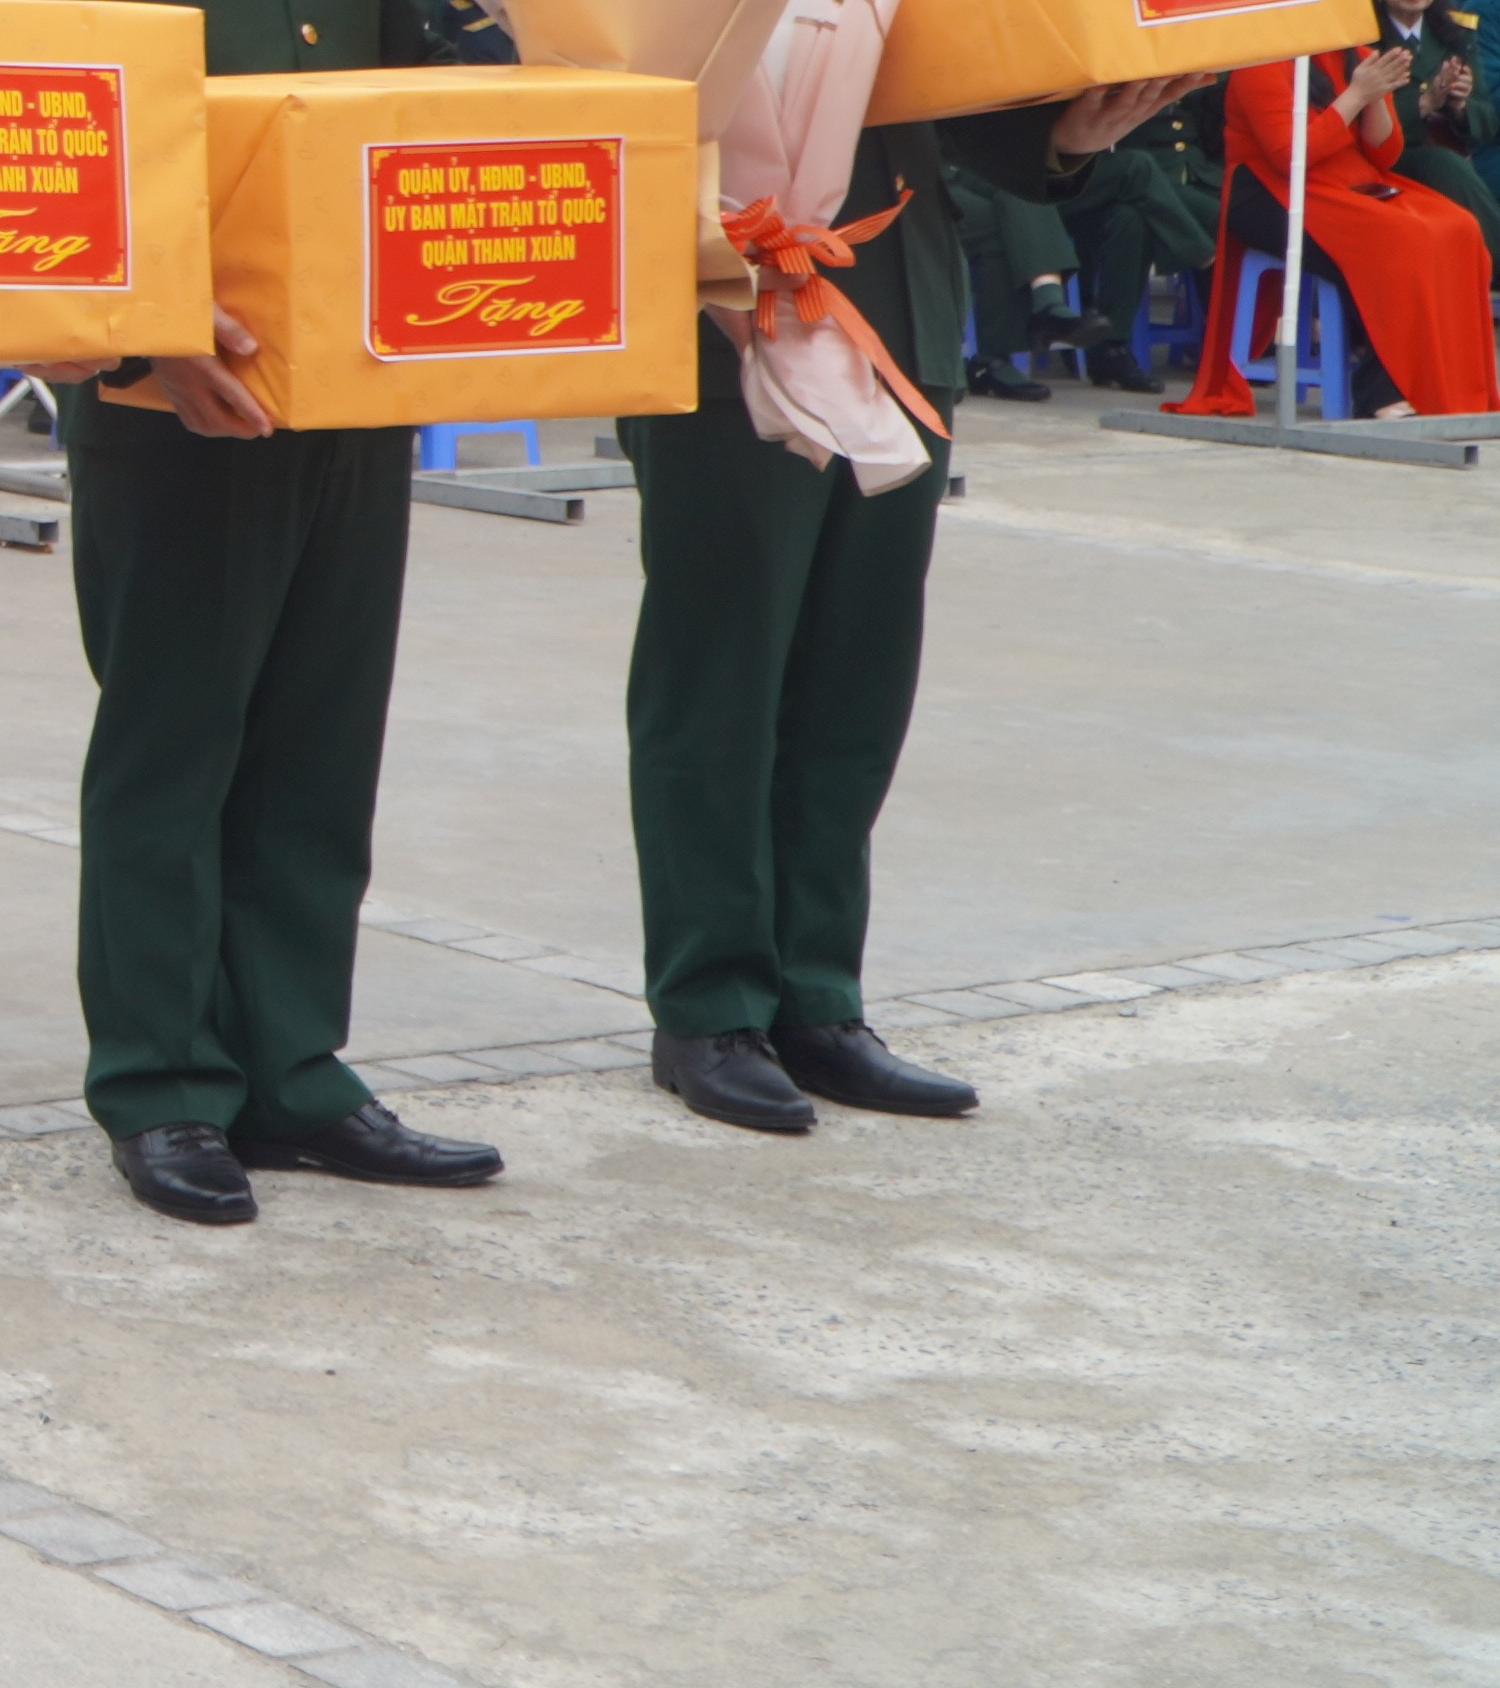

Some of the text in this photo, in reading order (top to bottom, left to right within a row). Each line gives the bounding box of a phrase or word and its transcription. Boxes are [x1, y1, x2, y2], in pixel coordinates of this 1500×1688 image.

[39, 91, 92, 121] UBND,
[37, 119, 58, 156] TỔ
[63, 120, 108, 158] QUỐC
[31, 161, 78, 193] XUÂN
[399, 163, 444, 200] QUẬN
[449, 156, 476, 194] ỦY,
[480, 165, 525, 191] HĐND
[541, 163, 591, 189] UBND,
[385, 189, 605, 234] ỦY BAN MẶT TRẬN TỔ QUỐC
[422, 230, 575, 271] QUẬN THANH XUÂN
[406, 275, 585, 336] Tặng
